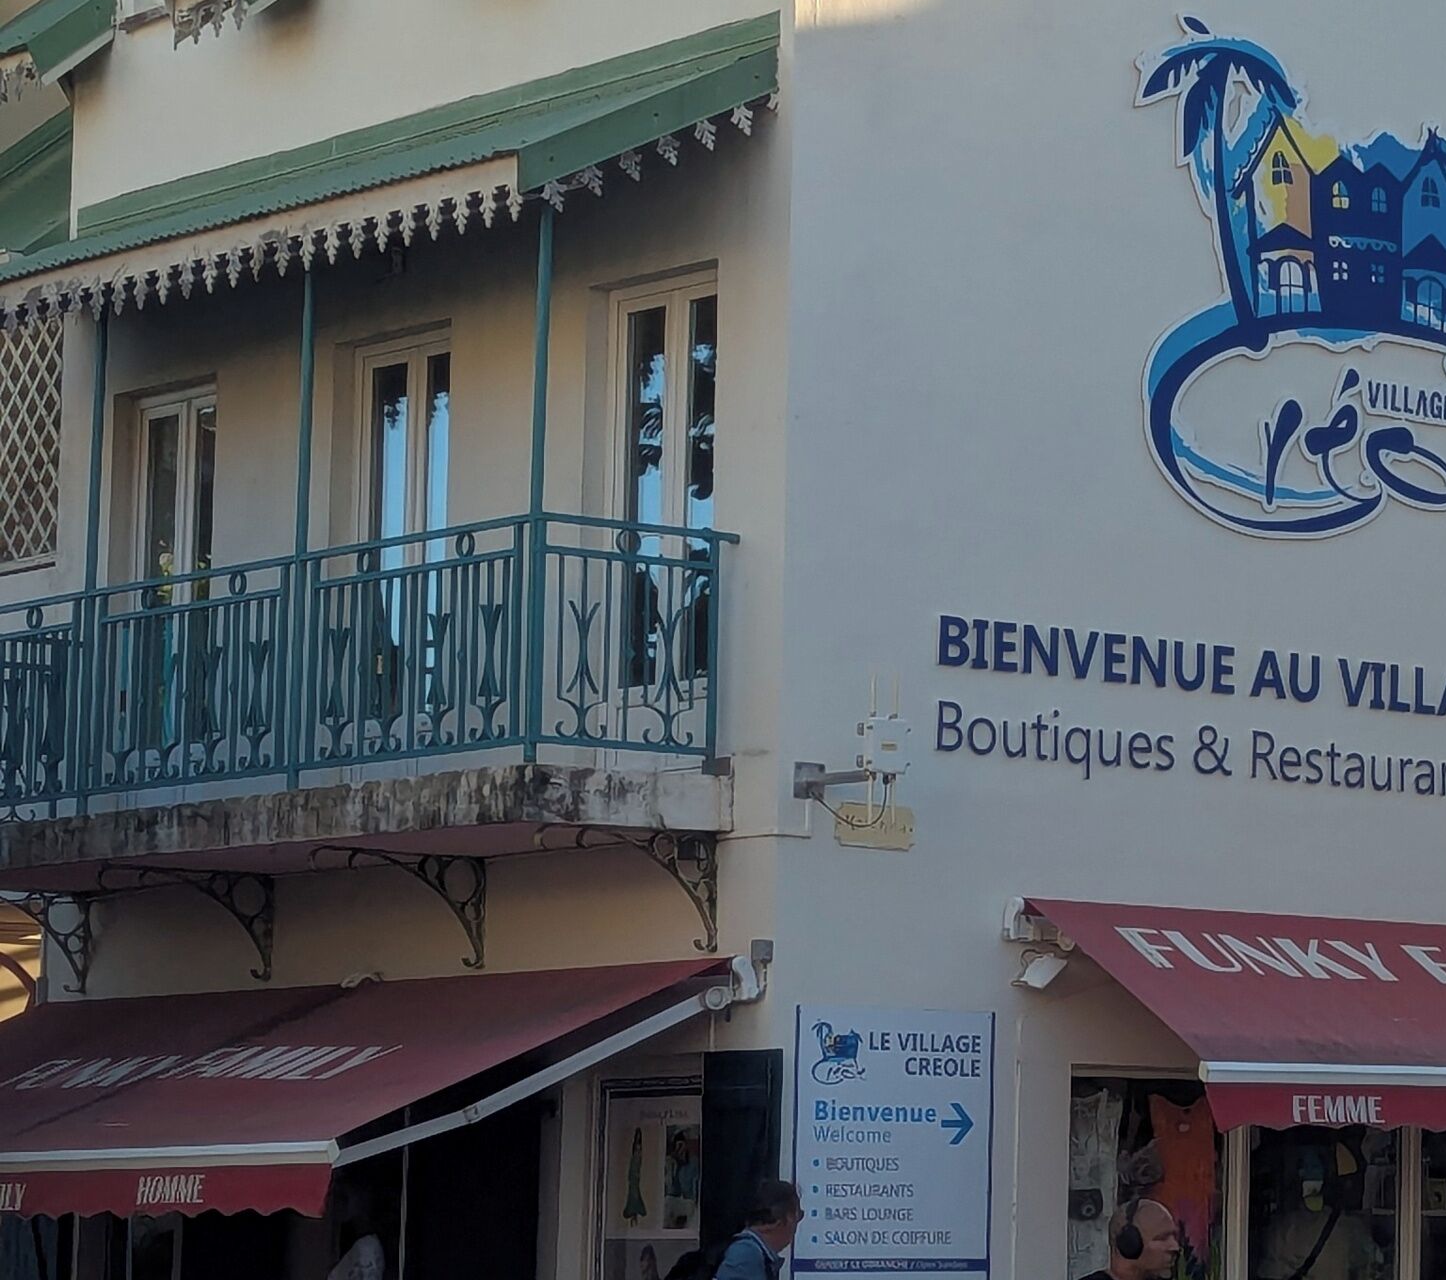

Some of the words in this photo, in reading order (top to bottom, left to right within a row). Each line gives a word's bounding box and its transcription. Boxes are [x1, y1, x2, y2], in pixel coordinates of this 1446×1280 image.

[937, 614, 1236, 696] BIENVENUE
[1250, 649, 1321, 704] AU
[934, 699, 1175, 780] Boutiques
[1193, 723, 1233, 777] &
[1113, 925, 1400, 983] FUNKY
[868, 1031, 891, 1051] LE
[897, 1032, 982, 1054] VILLAGE
[157, 1044, 403, 1081] FAMILY
[904, 1056, 982, 1078] CREOLE
[815, 1099, 937, 1123] Bienvenue
[1291, 1094, 1386, 1125] FEMME
[813, 1125, 892, 1144] Welcome
[826, 1157, 899, 1173] BOUTIQUES
[136, 1174, 206, 1206] HOMME
[825, 1183, 914, 1198] RESTAURANTS
[825, 1206, 857, 1221] BARS
[861, 1207, 914, 1221] LOUNGE
[824, 1230, 868, 1245] SALON
[871, 1230, 889, 1245] DE
[891, 1230, 953, 1245] COIFFURE
